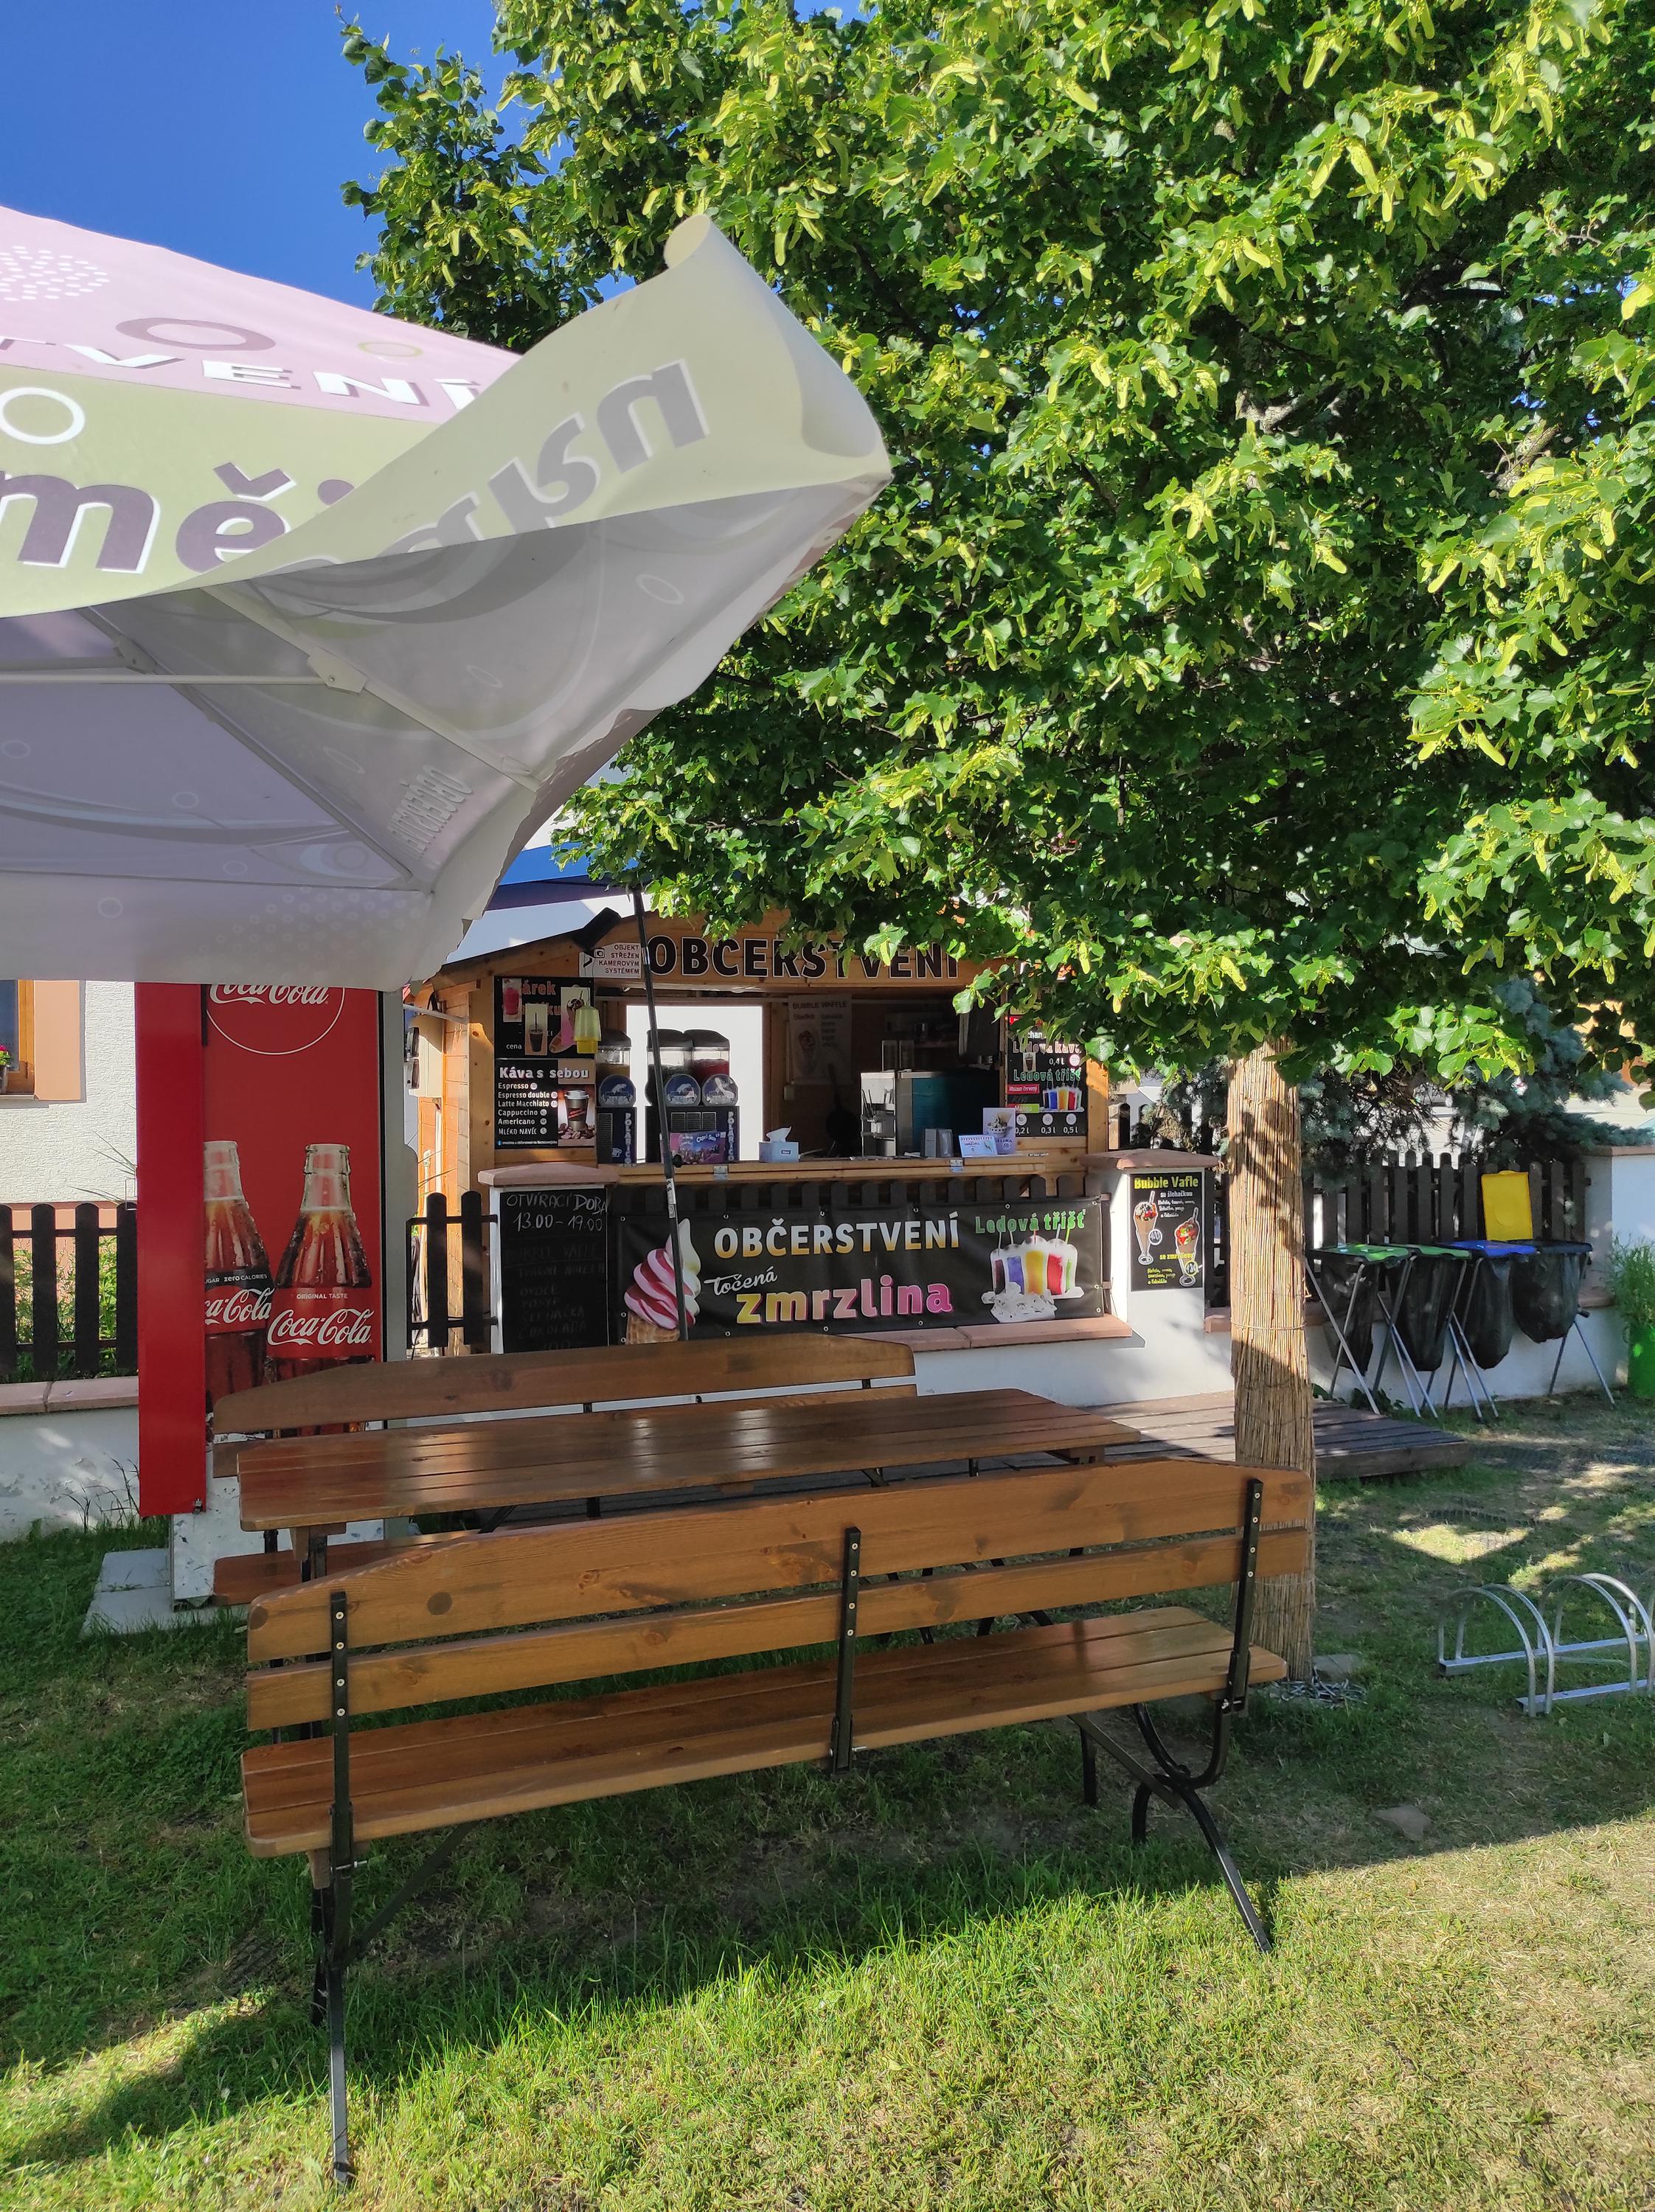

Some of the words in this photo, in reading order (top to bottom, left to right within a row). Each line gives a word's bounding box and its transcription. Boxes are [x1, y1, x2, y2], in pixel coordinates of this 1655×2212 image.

[521, 979, 556, 995] árek
[1049, 1058, 1061, 1066] 0,4
[499, 1066, 533, 1079] Káva
[536, 1069, 544, 1078] s
[549, 1067, 589, 1078] sebou
[1013, 1068, 1053, 1082] Ledová
[498, 1082, 529, 1091] Espresso
[498, 1091, 527, 1099] Espresso
[498, 1109, 538, 1117] Cappuccino
[1015, 1127, 1025, 1135] 0,2
[1041, 1127, 1052, 1135] 0,3
[1134, 1176, 1169, 1189] Bubble
[1171, 1175, 1198, 1188] Vafle
[506, 1192, 572, 1208] OTVÍRACÍ
[573, 1194, 608, 1215] DOBA
[975, 1212, 1039, 1234] Ledová
[1044, 1208, 1086, 1231] tříšť
[713, 1211, 960, 1259] OBČERSTVENÍ
[241, 1273, 268, 1281] CALORIES
[704, 1266, 778, 1295] točená
[205, 1287, 274, 1325] a-Cola
[736, 1274, 955, 1324] zmrzlina
[267, 1309, 375, 1345] Coca-Cola
